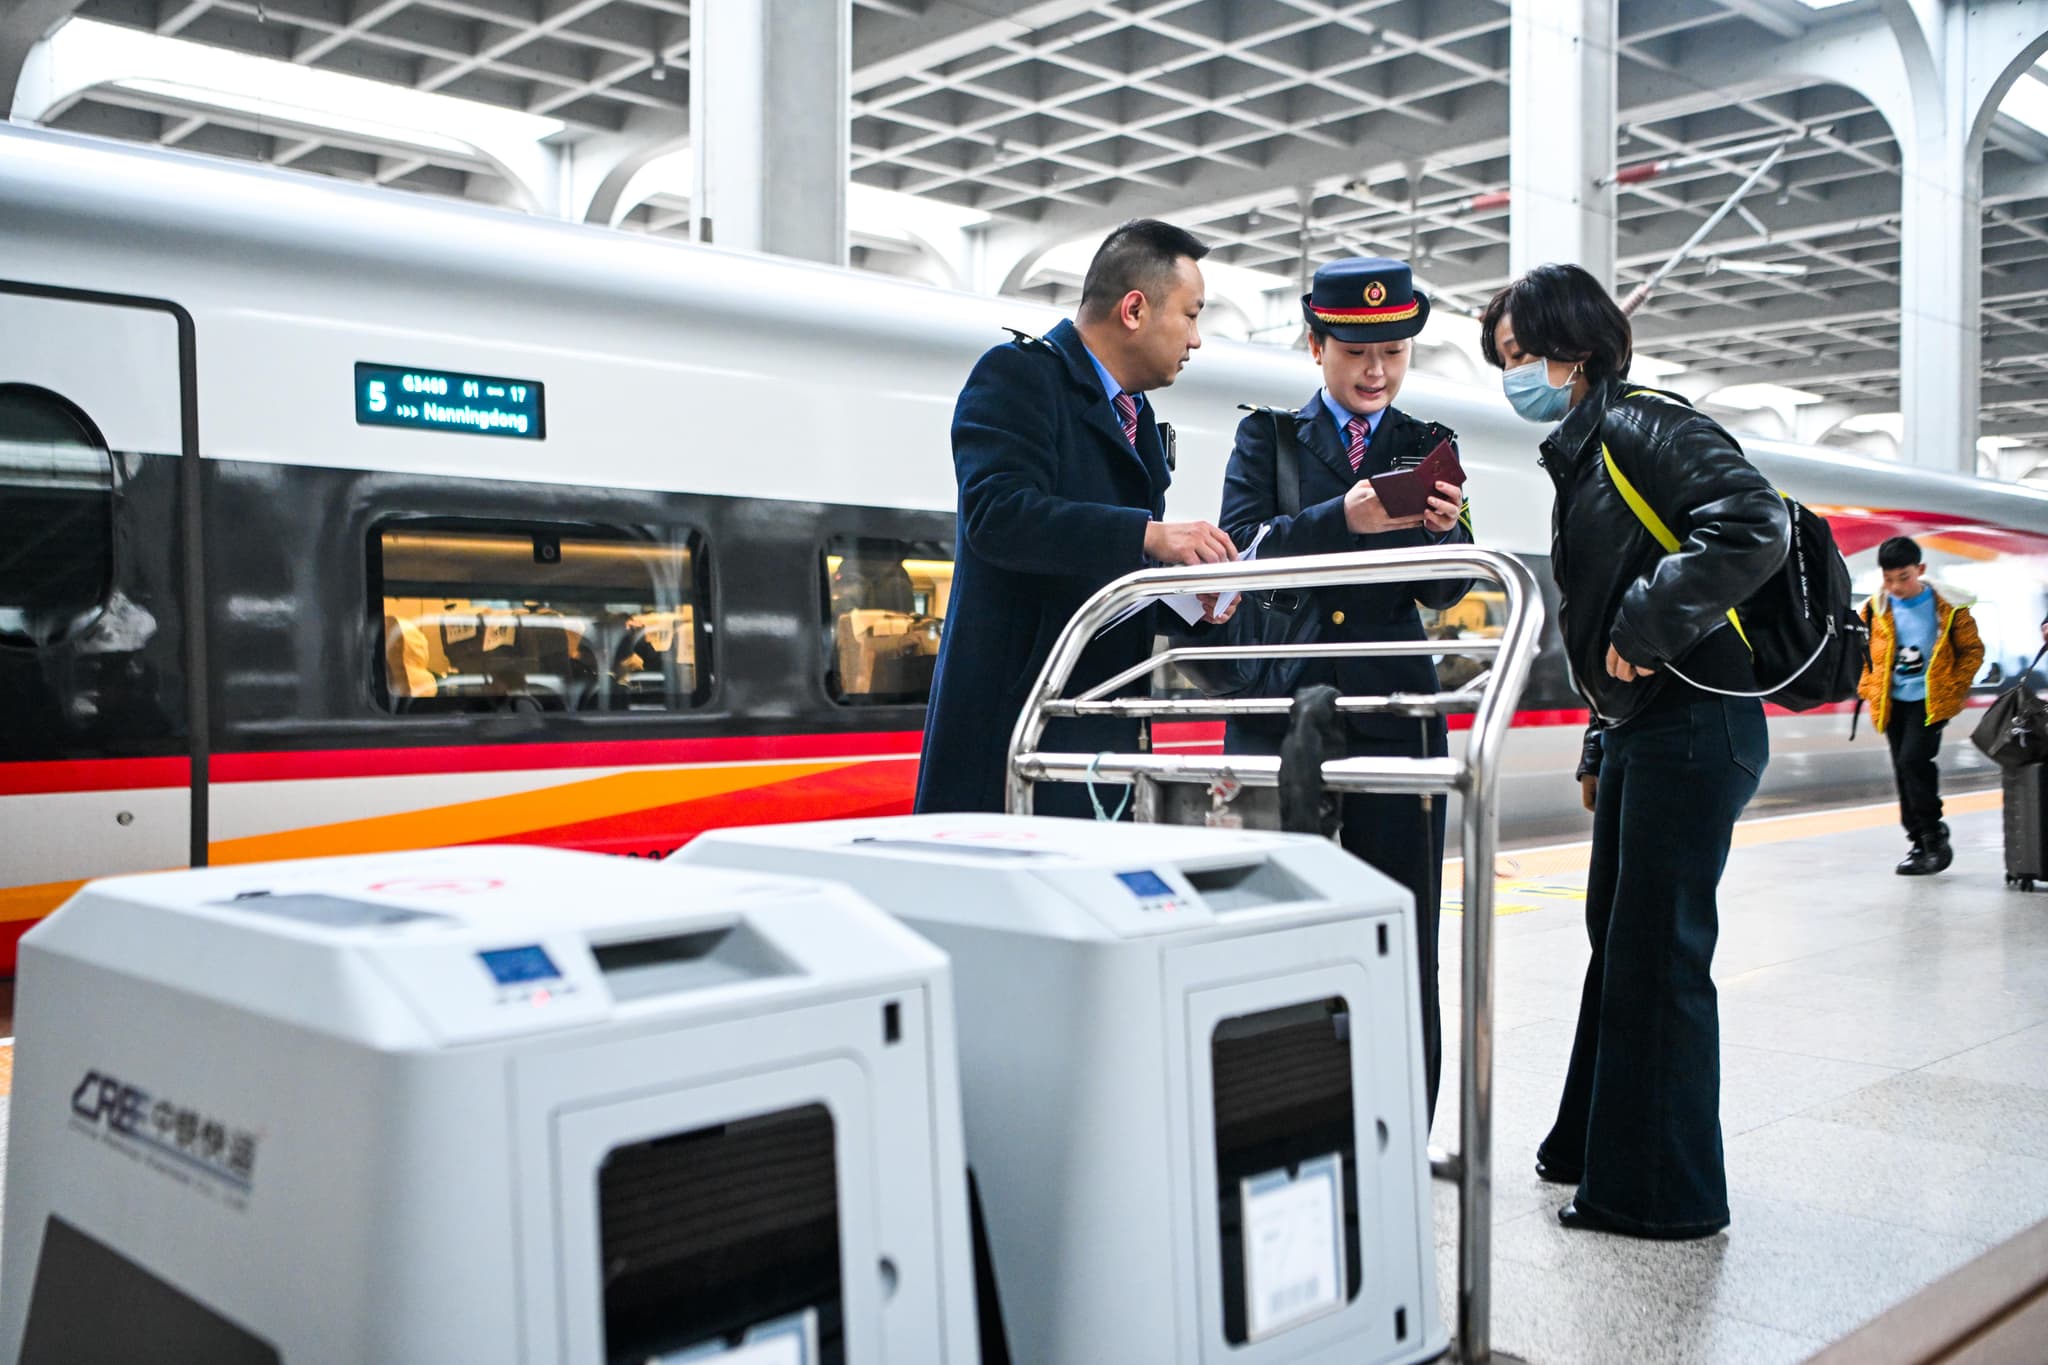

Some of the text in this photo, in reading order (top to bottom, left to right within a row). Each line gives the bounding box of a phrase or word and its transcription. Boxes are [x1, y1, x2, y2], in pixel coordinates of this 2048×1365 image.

[368, 379, 387, 412] 5
[462, 380, 479, 399] 01
[510, 385, 527, 403] 17
[422, 401, 529, 433] Nanningdong
